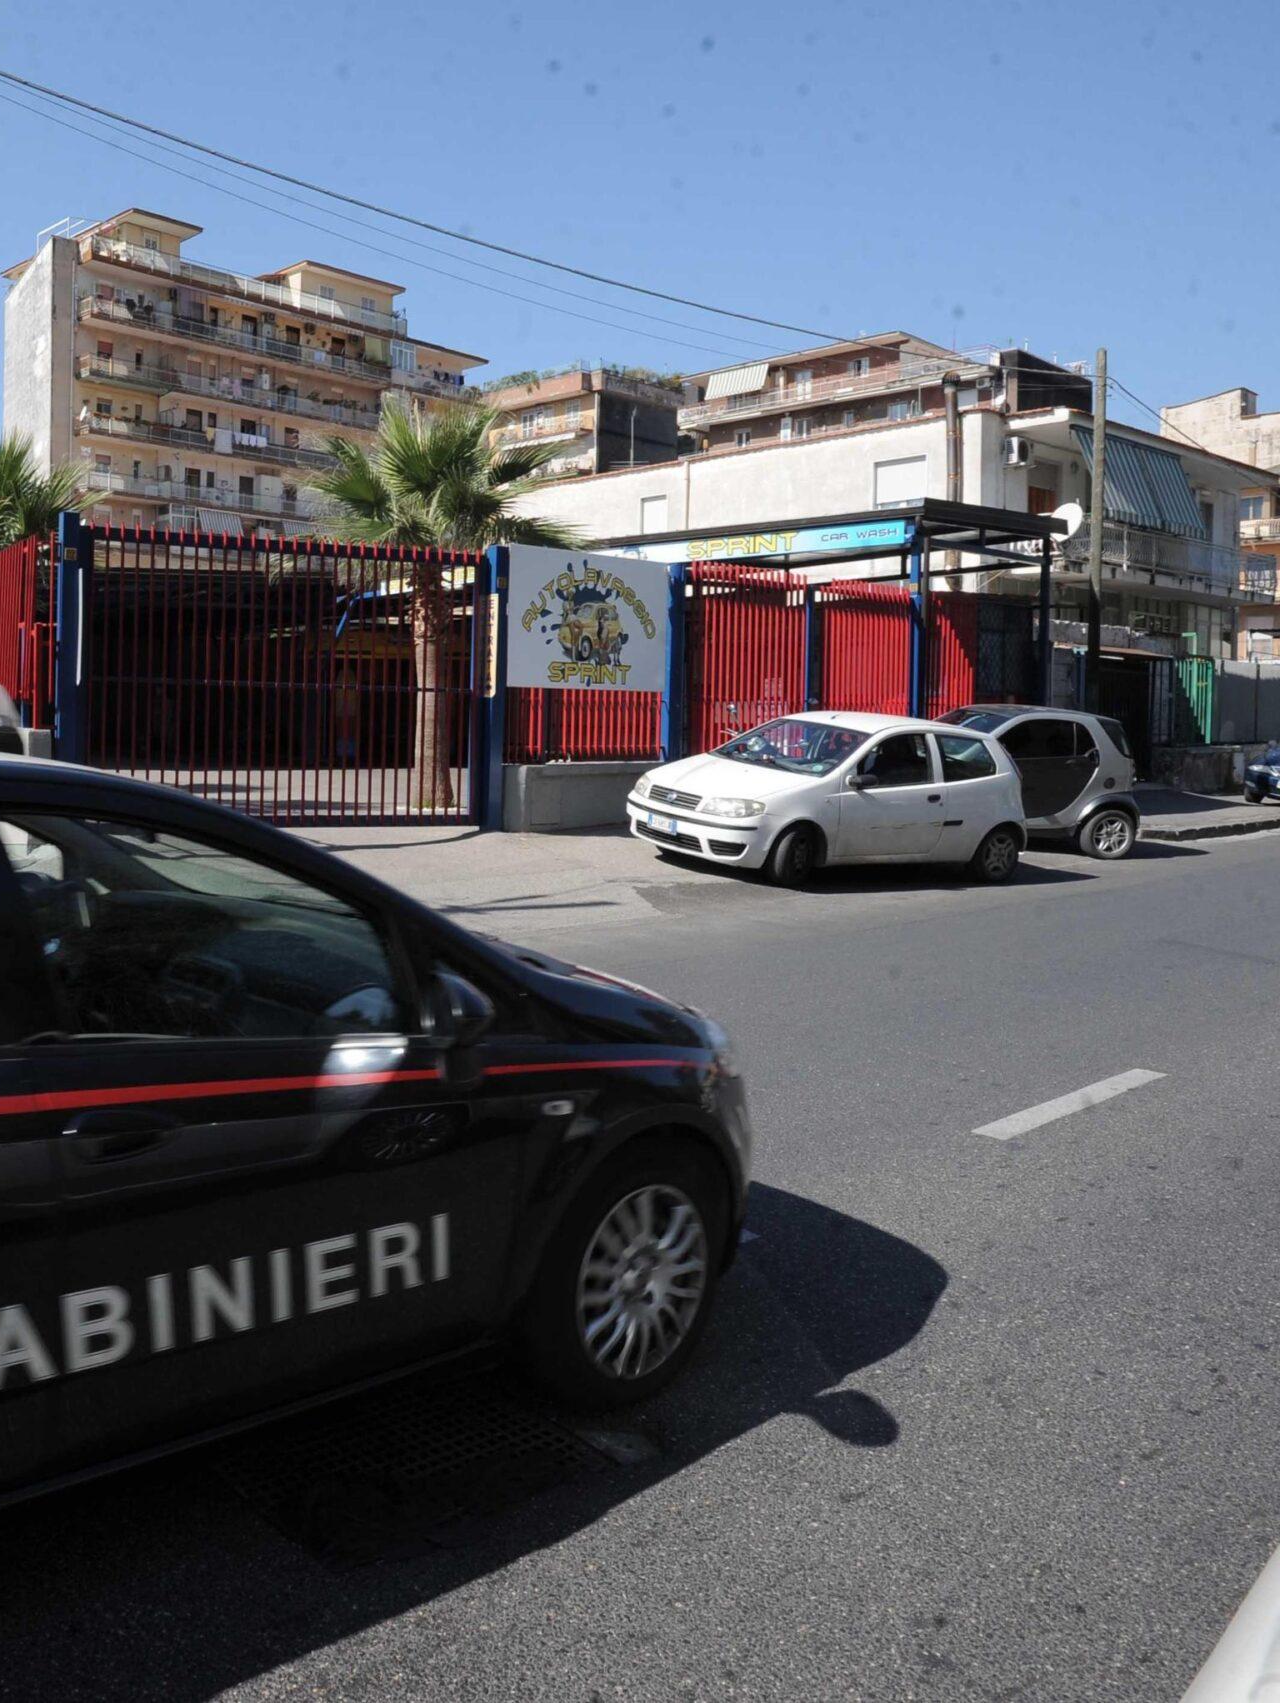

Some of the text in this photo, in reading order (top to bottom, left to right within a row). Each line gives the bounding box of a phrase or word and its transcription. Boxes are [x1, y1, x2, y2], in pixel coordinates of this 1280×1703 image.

[687, 528, 899, 560] SPRINT CAR WASH
[521, 567, 657, 640] AUTOLAVAGGIO
[547, 660, 631, 686] SPRINT
